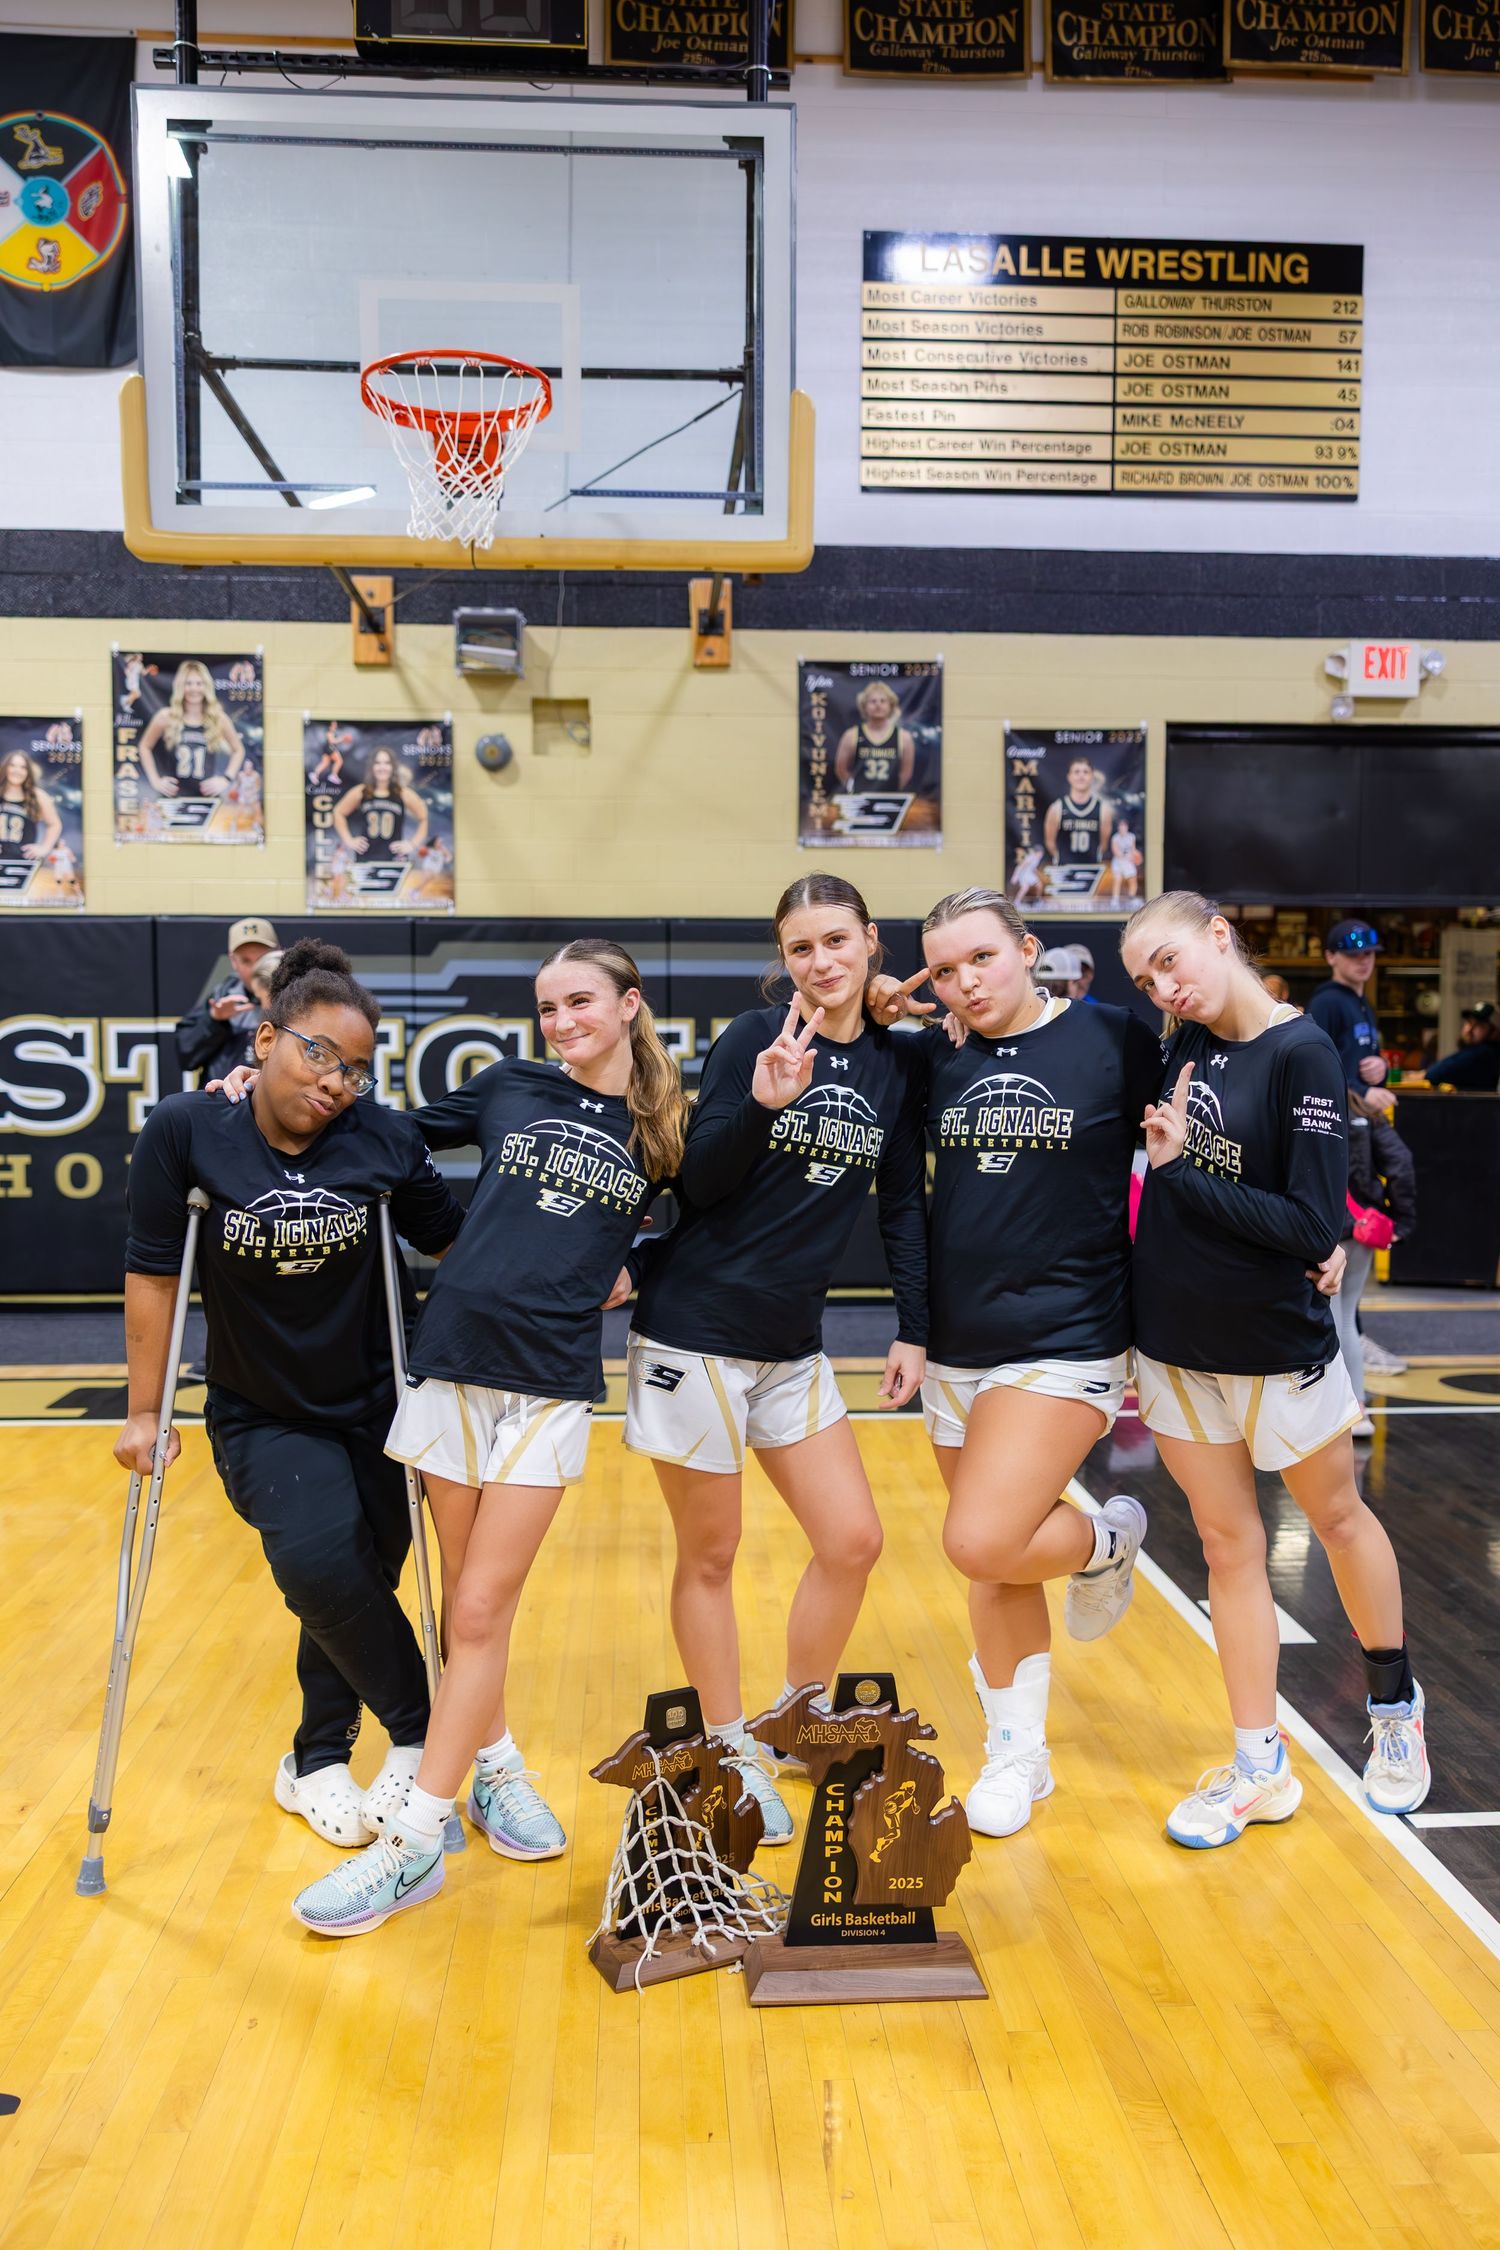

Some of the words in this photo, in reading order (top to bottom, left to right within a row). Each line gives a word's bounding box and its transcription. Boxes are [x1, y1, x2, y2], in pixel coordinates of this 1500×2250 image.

[898, 0, 975, 18] STATE
[1101, 3, 1177, 22] STATE
[1236, 0, 1399, 35] CHAMPION
[854, 7, 1018, 45] CHAMPION
[1057, 11, 1217, 48] CHAMPION
[651, 34, 680, 53] Joe
[869, 42, 934, 59] Galloway
[940, 46, 1006, 59] Thurston
[1270, 31, 1299, 51] Joe
[1304, 34, 1366, 50] Ostman
[1072, 46, 1138, 62] Galloway
[1465, 43, 1493, 61] Joe
[921, 244, 1086, 278] LASALLE
[1096, 247, 1310, 284] WRESTLING
[867, 289, 905, 302] Most
[911, 290, 962, 304] Career
[968, 291, 1038, 307] Victories
[1124, 294, 1195, 310] GALLOWAY
[1202, 297, 1273, 312] THURSTON
[1332, 300, 1358, 315] 212
[867, 318, 906, 333] Most
[911, 319, 969, 335] Season
[974, 321, 1044, 337] Victories
[1122, 323, 1149, 337] ROB
[1257, 328, 1312, 343] OSTMAN
[1338, 329, 1358, 345] 57
[867, 348, 906, 362] Most
[914, 349, 1013, 366] Consecutive
[1019, 351, 1089, 367] Victories
[1123, 353, 1154, 368] JOE
[1162, 355, 1231, 370] OSTMAN
[1337, 358, 1360, 374] 141
[866, 378, 905, 392] Most
[910, 379, 968, 393] Season
[974, 380, 1009, 395] Pins
[1122, 382, 1153, 397] JOE
[1161, 384, 1230, 399] OSTMAN
[1338, 388, 1358, 402] 45
[866, 407, 925, 422] Fastest
[932, 408, 956, 423] Pin
[1121, 413, 1162, 429] MIKE
[1170, 415, 1246, 430] McNEELY
[866, 436, 922, 454] Highest
[927, 438, 973, 450] Career
[979, 438, 1006, 451] Win
[1011, 440, 1093, 457] Percentage
[1120, 441, 1153, 456] JOE
[1159, 442, 1228, 457] OSTMAN
[866, 466, 921, 483] Highest
[926, 467, 980, 481] Season
[984, 468, 1012, 482] Win
[1016, 469, 1097, 489] Percentage
[1120, 469, 1174, 485] RICHARD
[1258, 472, 1309, 488] OSTMAN
[1315, 474, 1354, 489] 100%
[849, 663, 899, 677] SENIOR
[1363, 645, 1413, 681] EXIT
[214, 679, 262, 691] SENIORS
[31, 739, 82, 752] SENIORS
[1055, 731, 1104, 744] SENIOR
[402, 743, 452, 756] SENIORS
[864, 759, 890, 780] 32
[1069, 831, 1091, 853] 10
[940, 1107, 970, 1137] ST.
[975, 1106, 1075, 1140] IGNACE
[1292, 1107, 1342, 1123] NATIONAL
[770, 1109, 813, 1144] ST.
[815, 1115, 885, 1158] IGNACE
[940, 1137, 1069, 1151] BASKETBALL
[1183, 1113, 1242, 1175] NACE
[768, 1140, 877, 1170] BASKETBALL
[500, 1132, 540, 1168] ST.
[544, 1142, 648, 1207] IGNACE
[498, 1164, 633, 1216] BASKETBALL
[223, 1208, 267, 1248] ST.
[273, 1204, 369, 1248] IGNACE
[796, 1724, 871, 1745] MHSAA
[823, 1783, 846, 1904] CHAMPION
[709, 1852, 736, 1869] 025
[888, 1877, 925, 1890] 2025
[810, 1913, 842, 1927] Girls
[845, 1911, 916, 1926] Basketball
[841, 1929, 879, 1937] DIVISION
